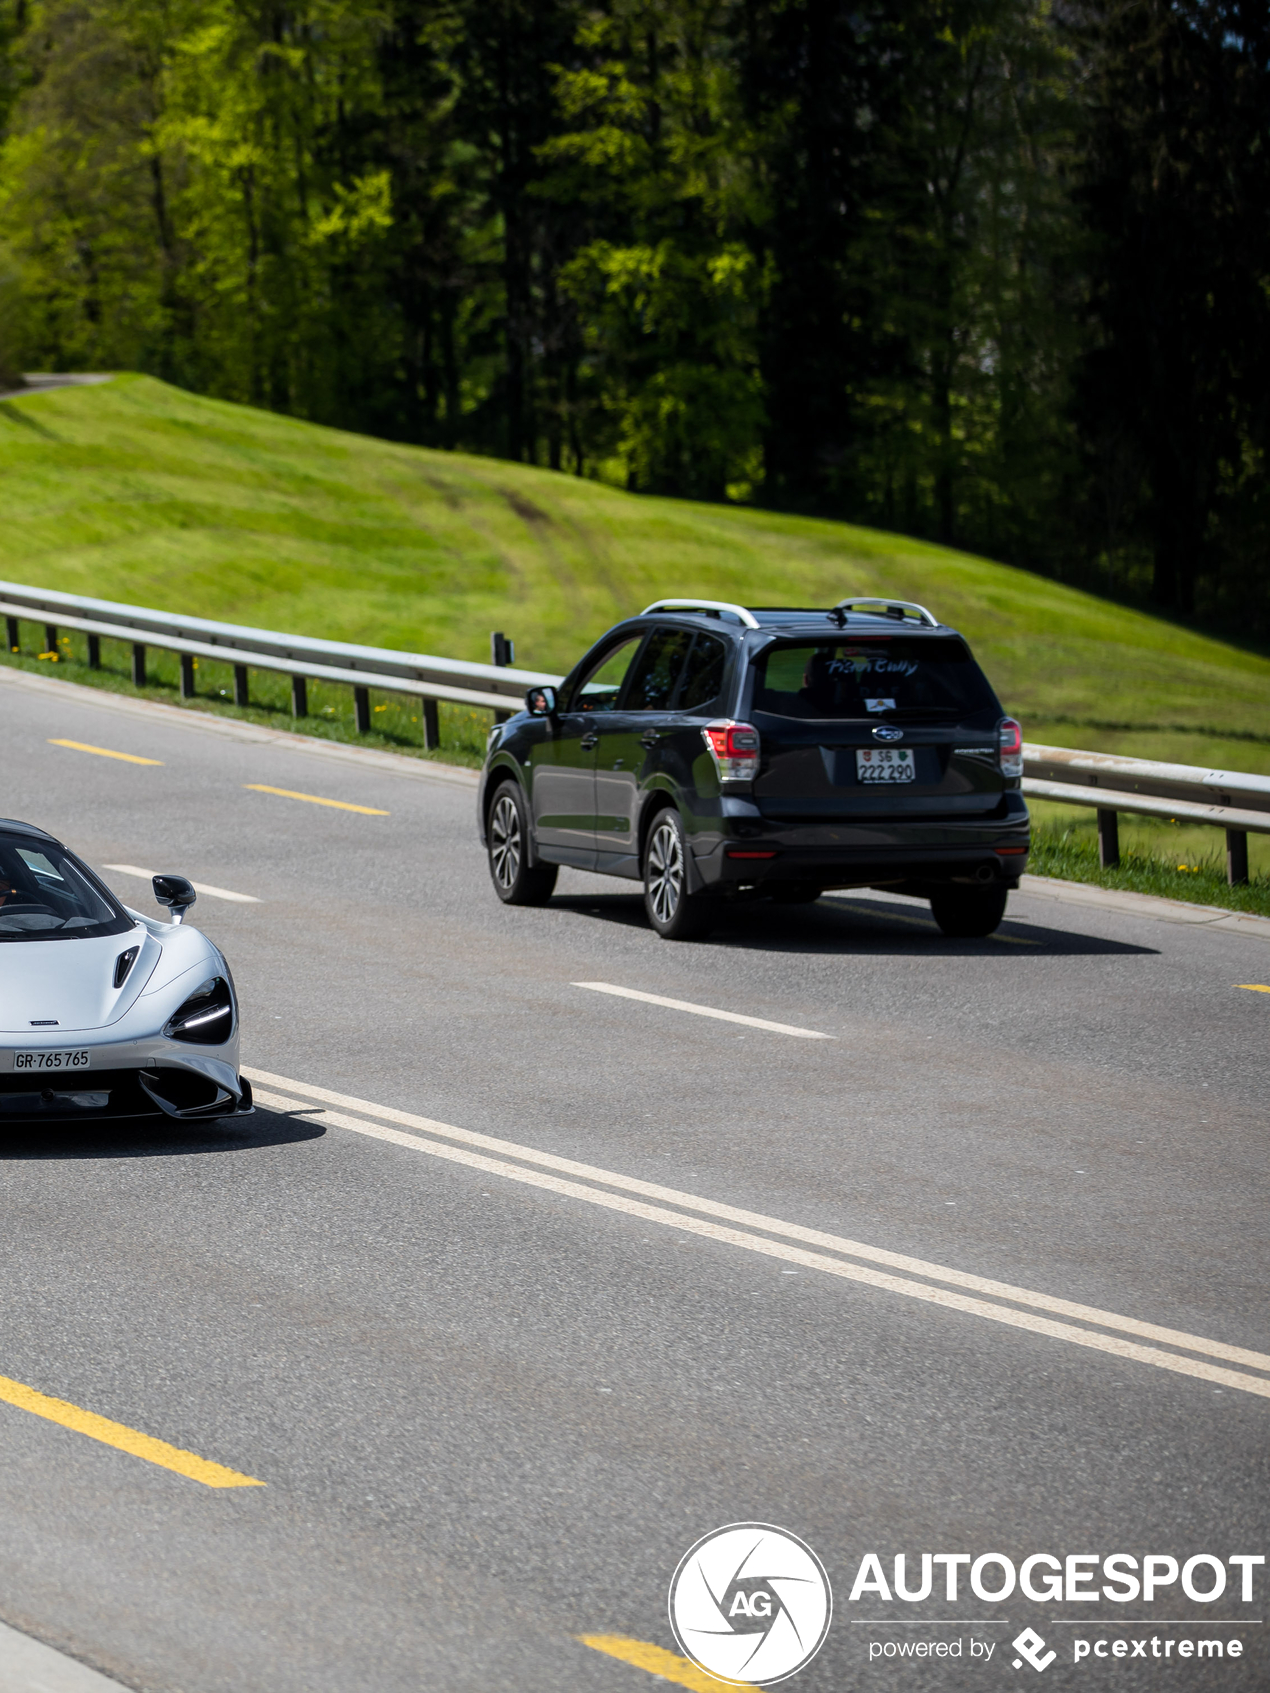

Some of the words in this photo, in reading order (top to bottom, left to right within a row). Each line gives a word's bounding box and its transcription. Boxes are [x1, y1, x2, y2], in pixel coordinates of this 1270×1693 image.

[878, 750, 893, 763] SG
[859, 764, 885, 780] 222
[886, 763, 913, 780] 290
[65, 1051, 89, 1066] 765
